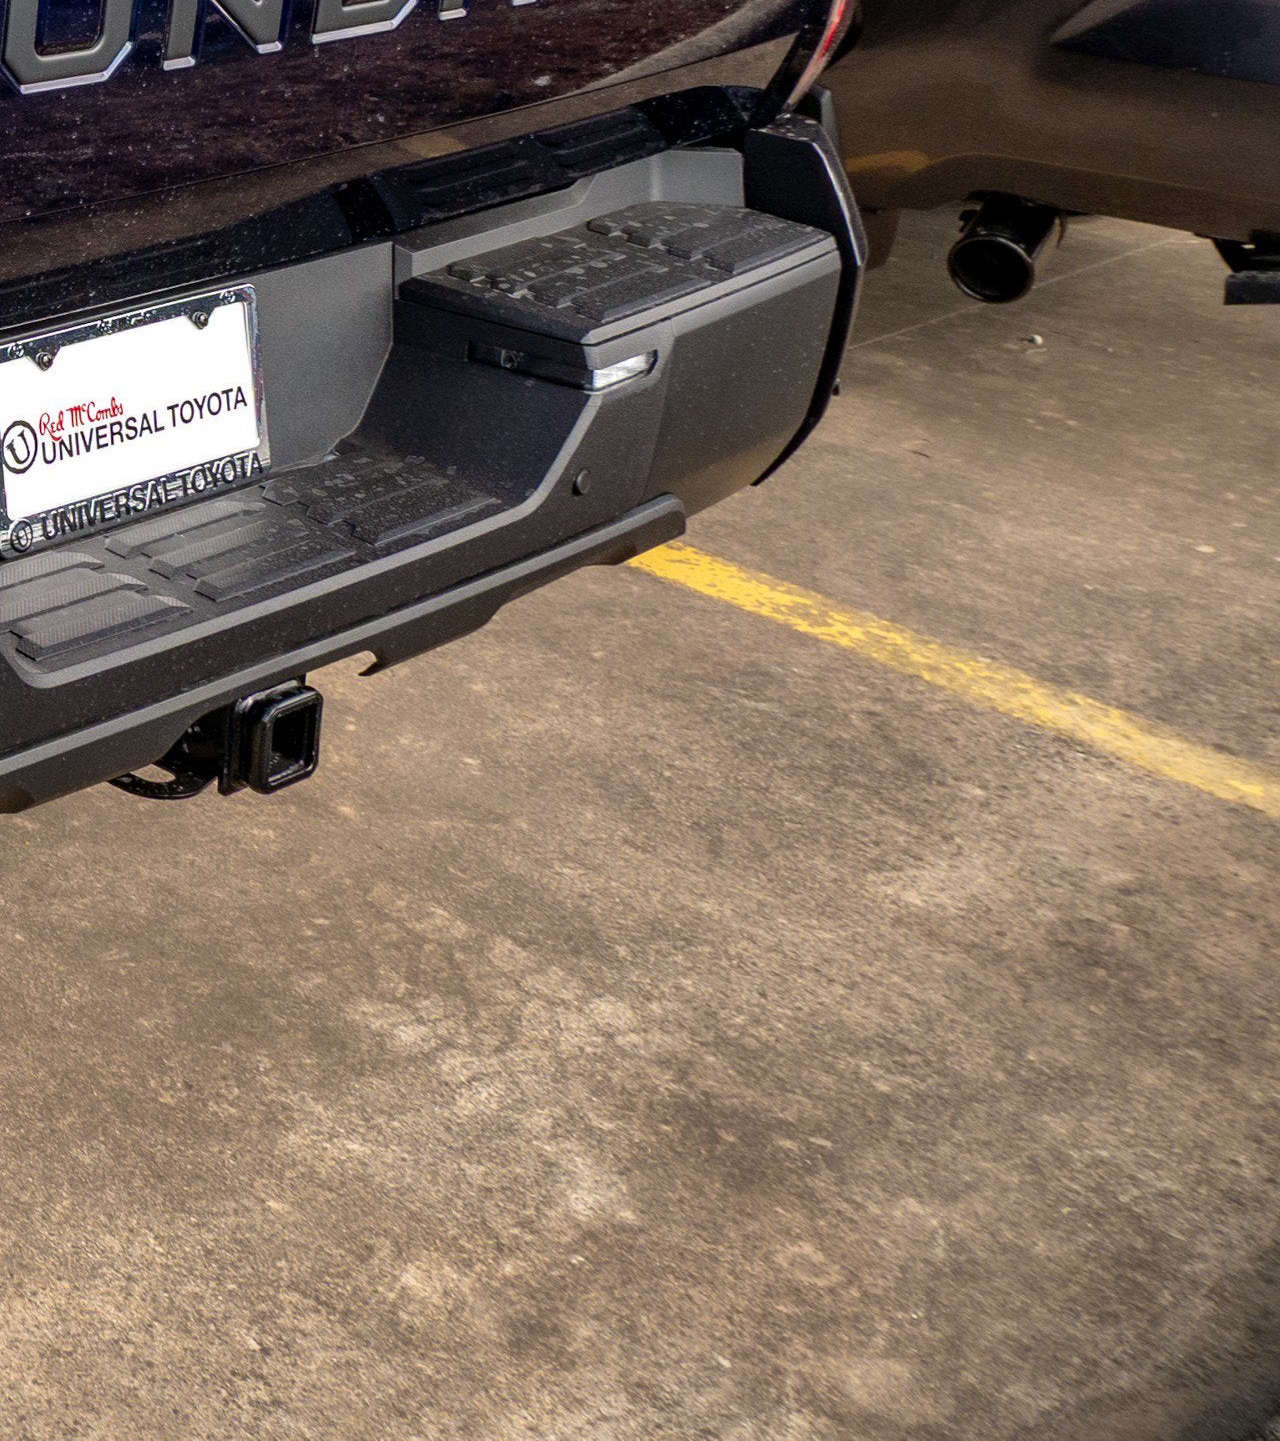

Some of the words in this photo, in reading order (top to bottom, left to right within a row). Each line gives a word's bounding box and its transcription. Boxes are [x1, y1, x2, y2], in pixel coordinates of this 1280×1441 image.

[38, 410, 65, 442] Red
[41, 410, 165, 465] UNIVERSAL
[166, 386, 248, 428] TOYOTA
[39, 478, 177, 540] UNIVERSAL
[175, 449, 263, 496] TOYOTA
